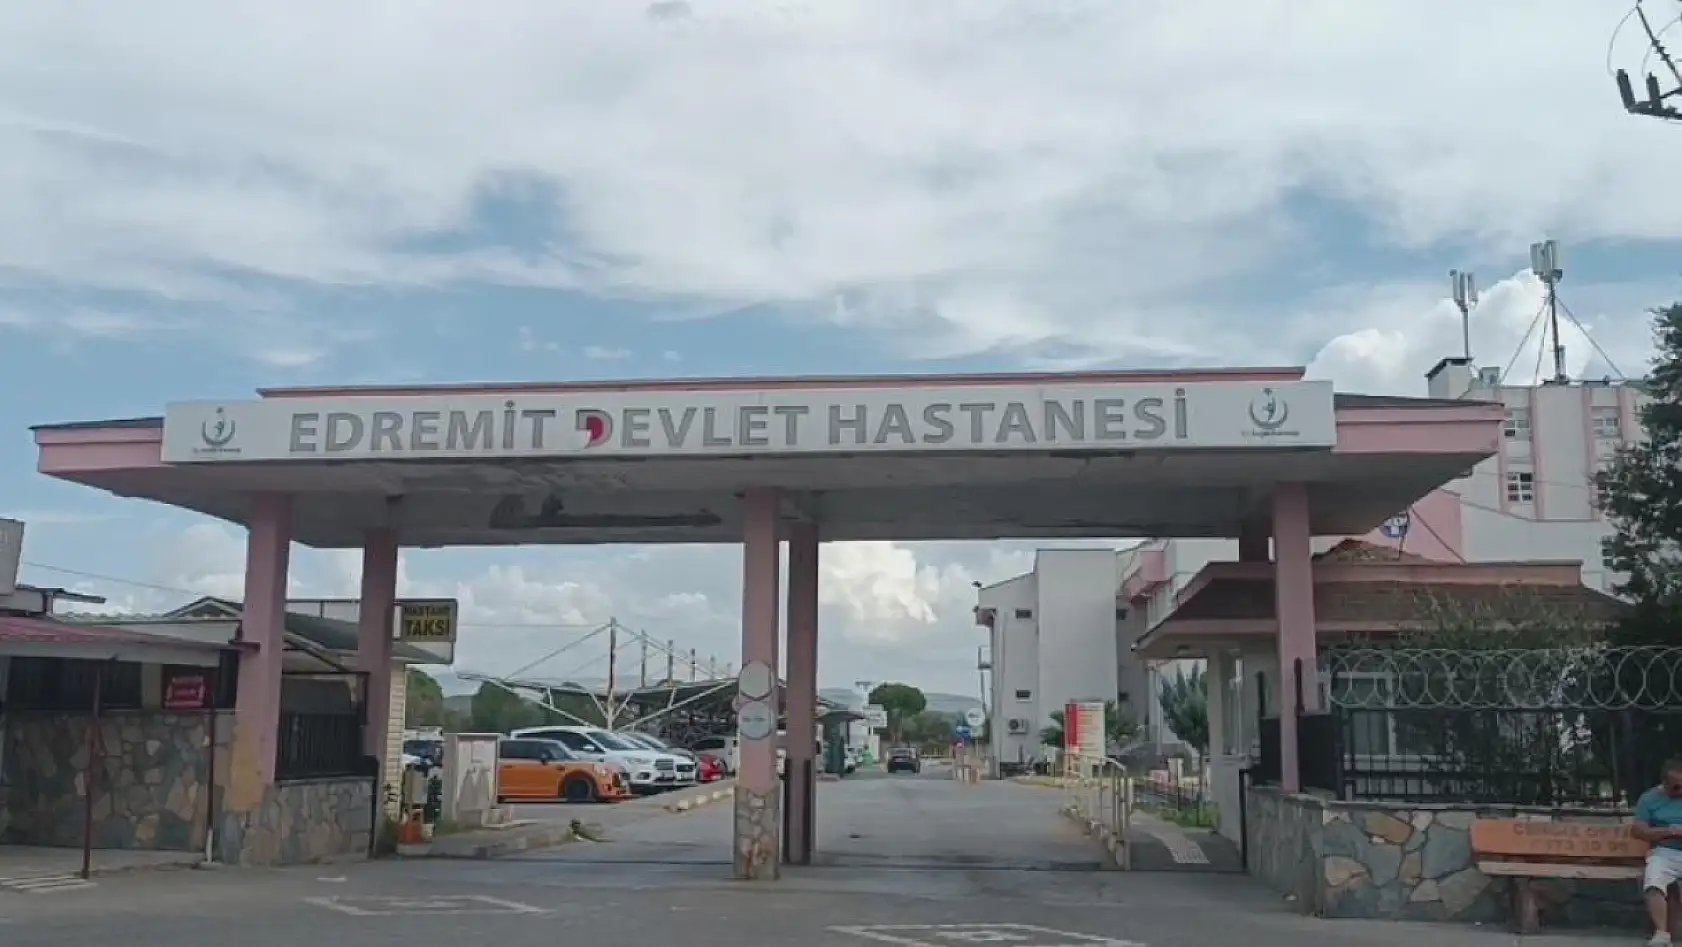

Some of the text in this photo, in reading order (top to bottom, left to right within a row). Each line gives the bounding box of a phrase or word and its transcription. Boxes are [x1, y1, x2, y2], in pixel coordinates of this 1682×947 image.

[289, 388, 1188, 452] EDREMİT DEVLET HASTANESİ
